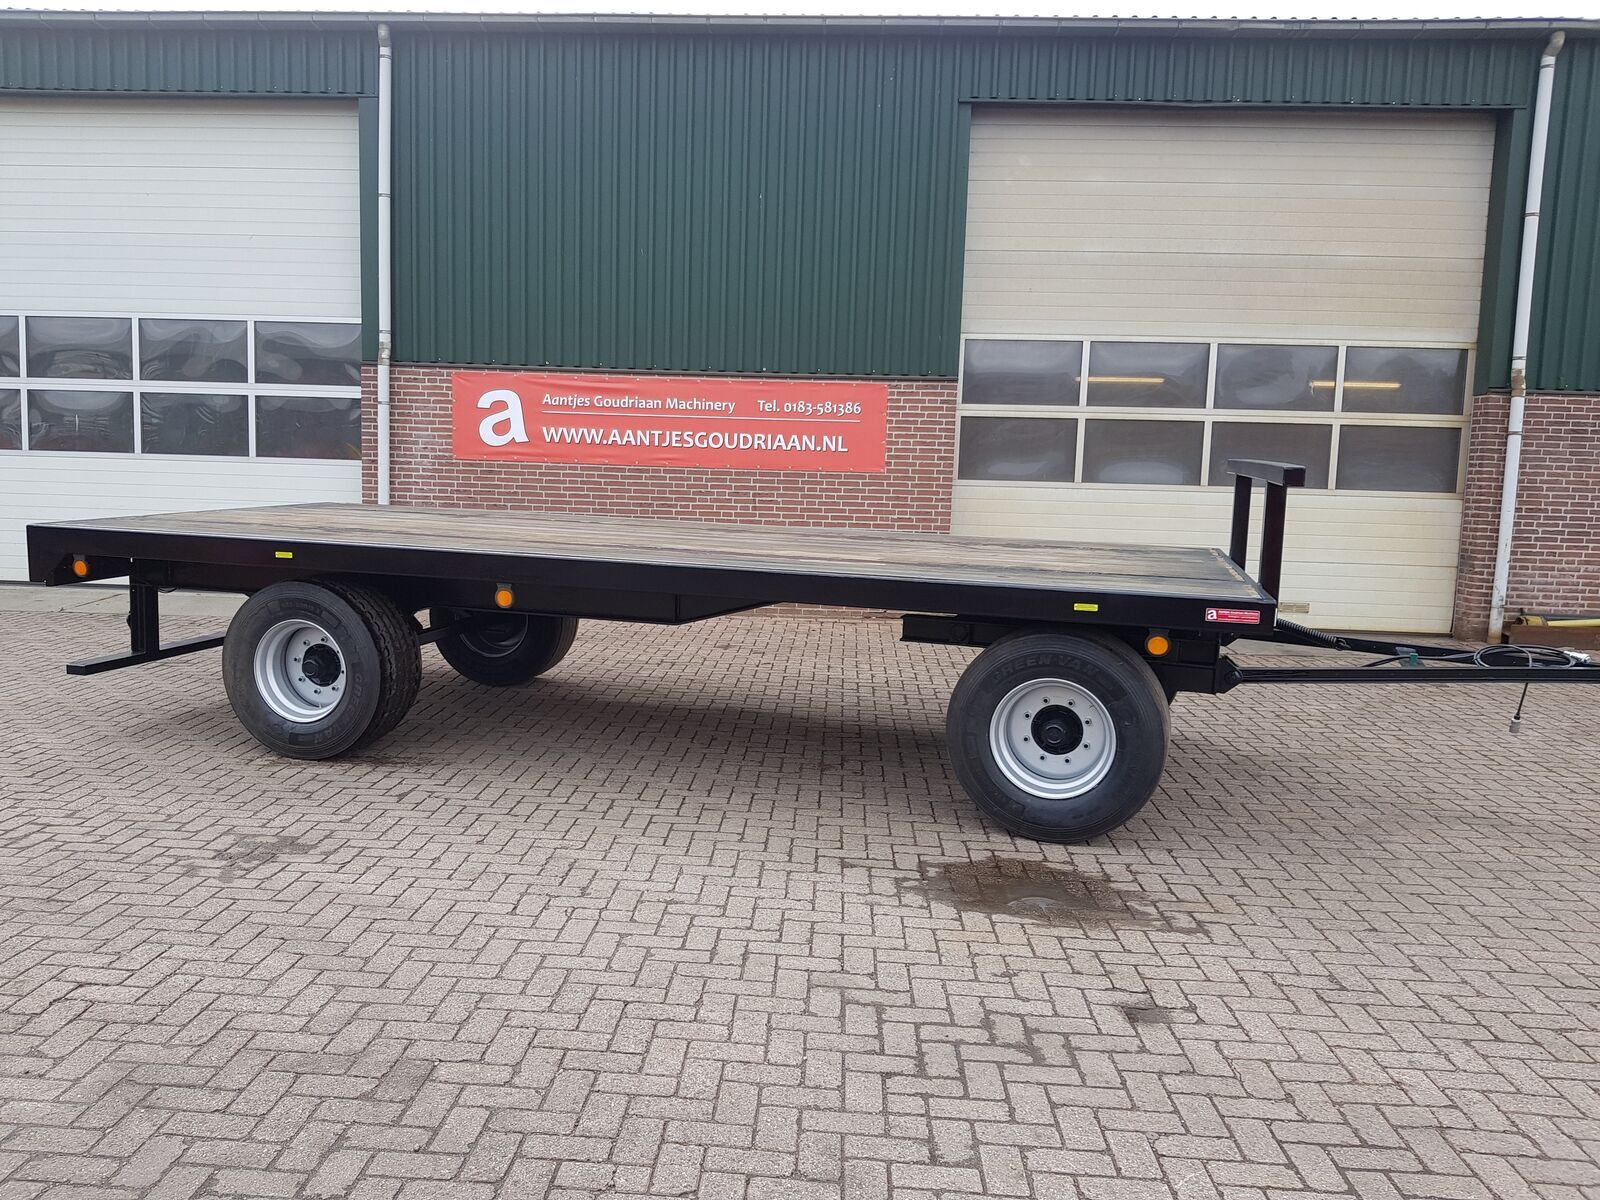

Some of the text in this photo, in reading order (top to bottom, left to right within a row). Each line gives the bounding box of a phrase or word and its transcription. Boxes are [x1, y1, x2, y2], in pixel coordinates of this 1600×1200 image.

[542, 393, 735, 414] Aantjes Goudriaan Machinery
[758, 399, 861, 416] Tel. 0183-581386
[477, 389, 528, 446] a
[542, 426, 848, 452] WWW.AANTJESGOUDRIAAN.NL
